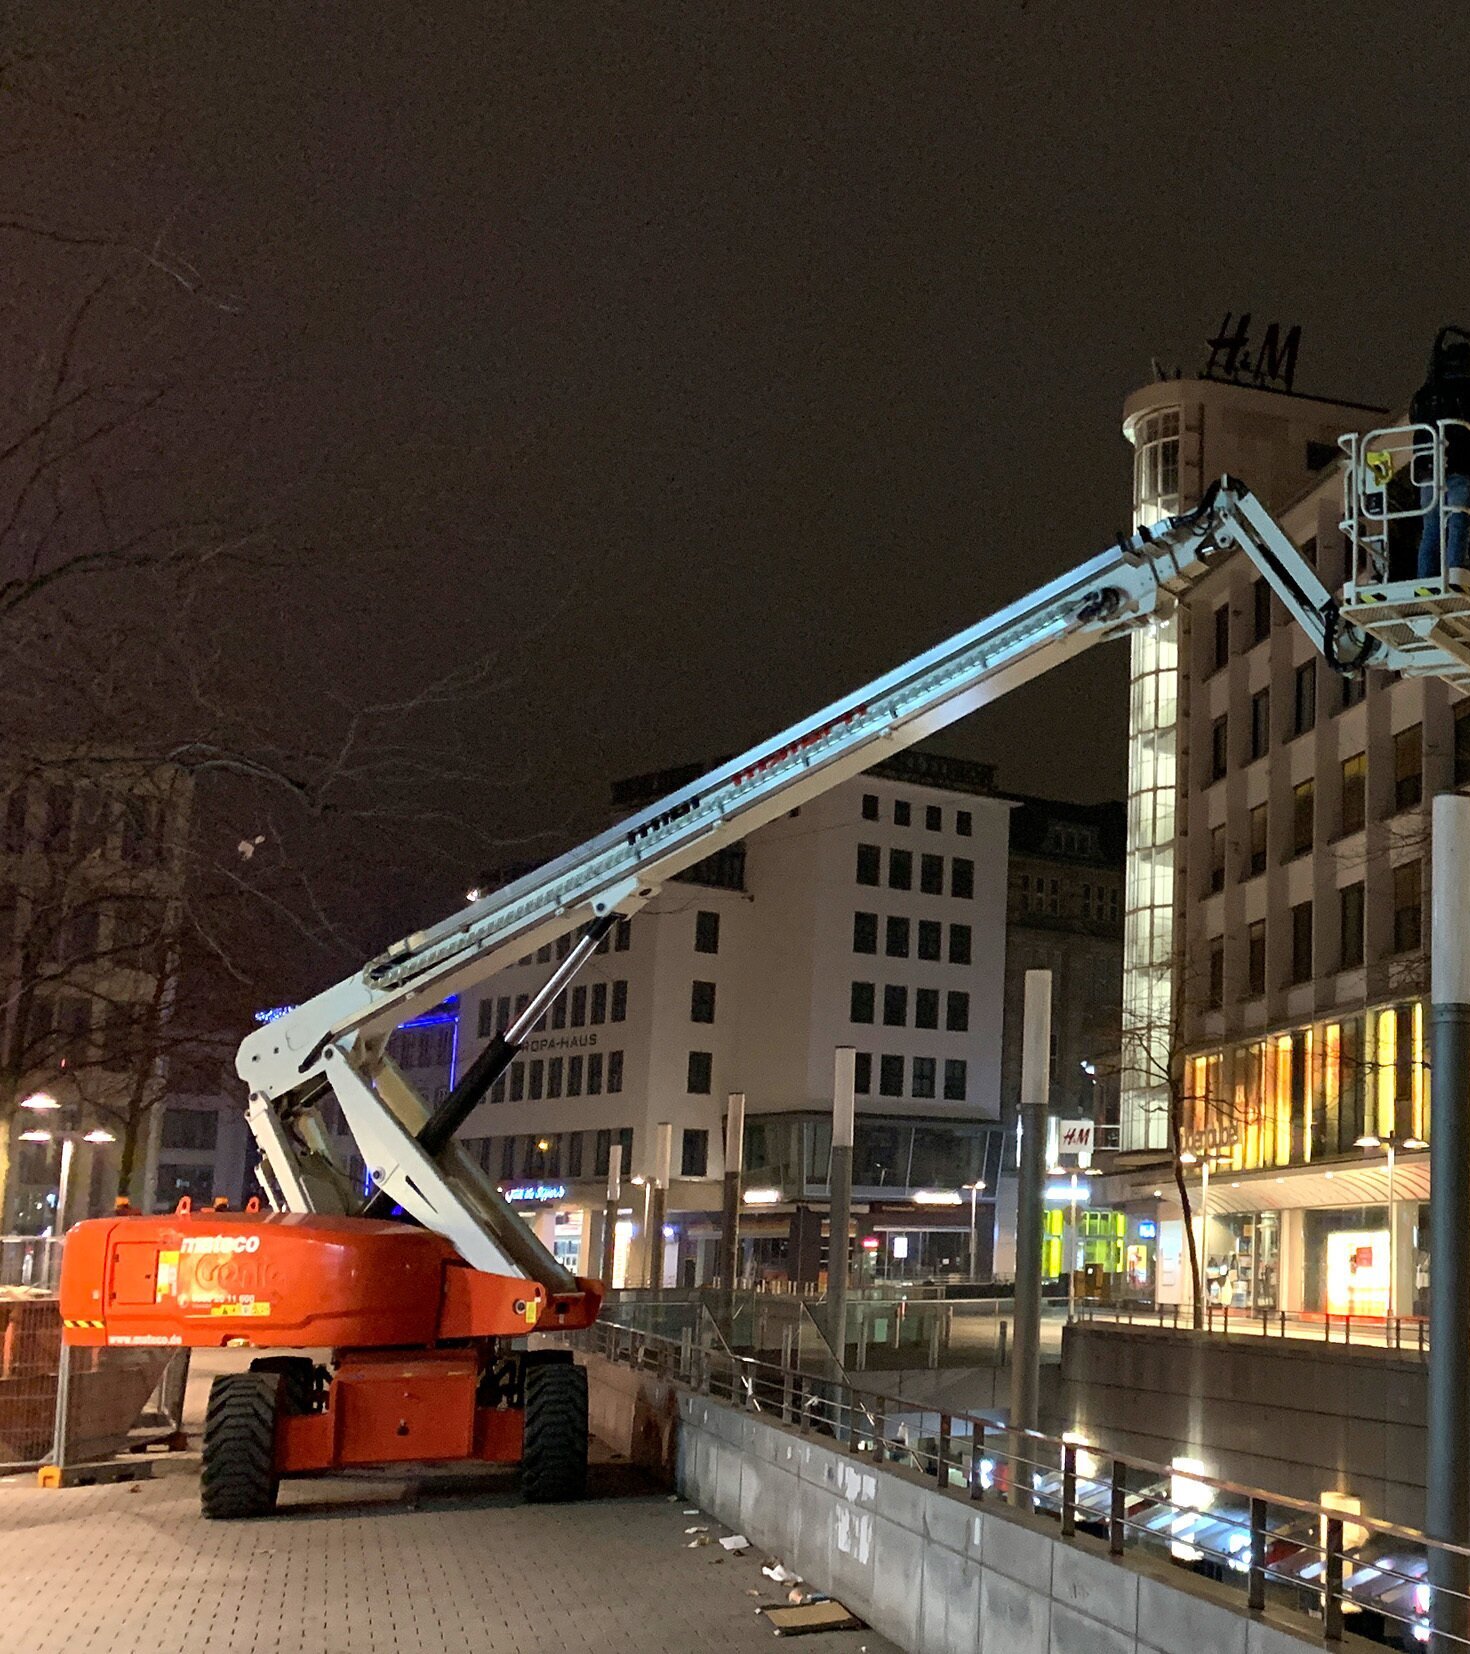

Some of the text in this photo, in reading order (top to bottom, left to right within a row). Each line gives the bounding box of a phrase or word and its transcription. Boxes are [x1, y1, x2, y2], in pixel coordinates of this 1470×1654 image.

[1206, 312, 1302, 391] H&M
[521, 1033, 597, 1053] ROPA-HAUS
[181, 1235, 260, 1254] mateco
